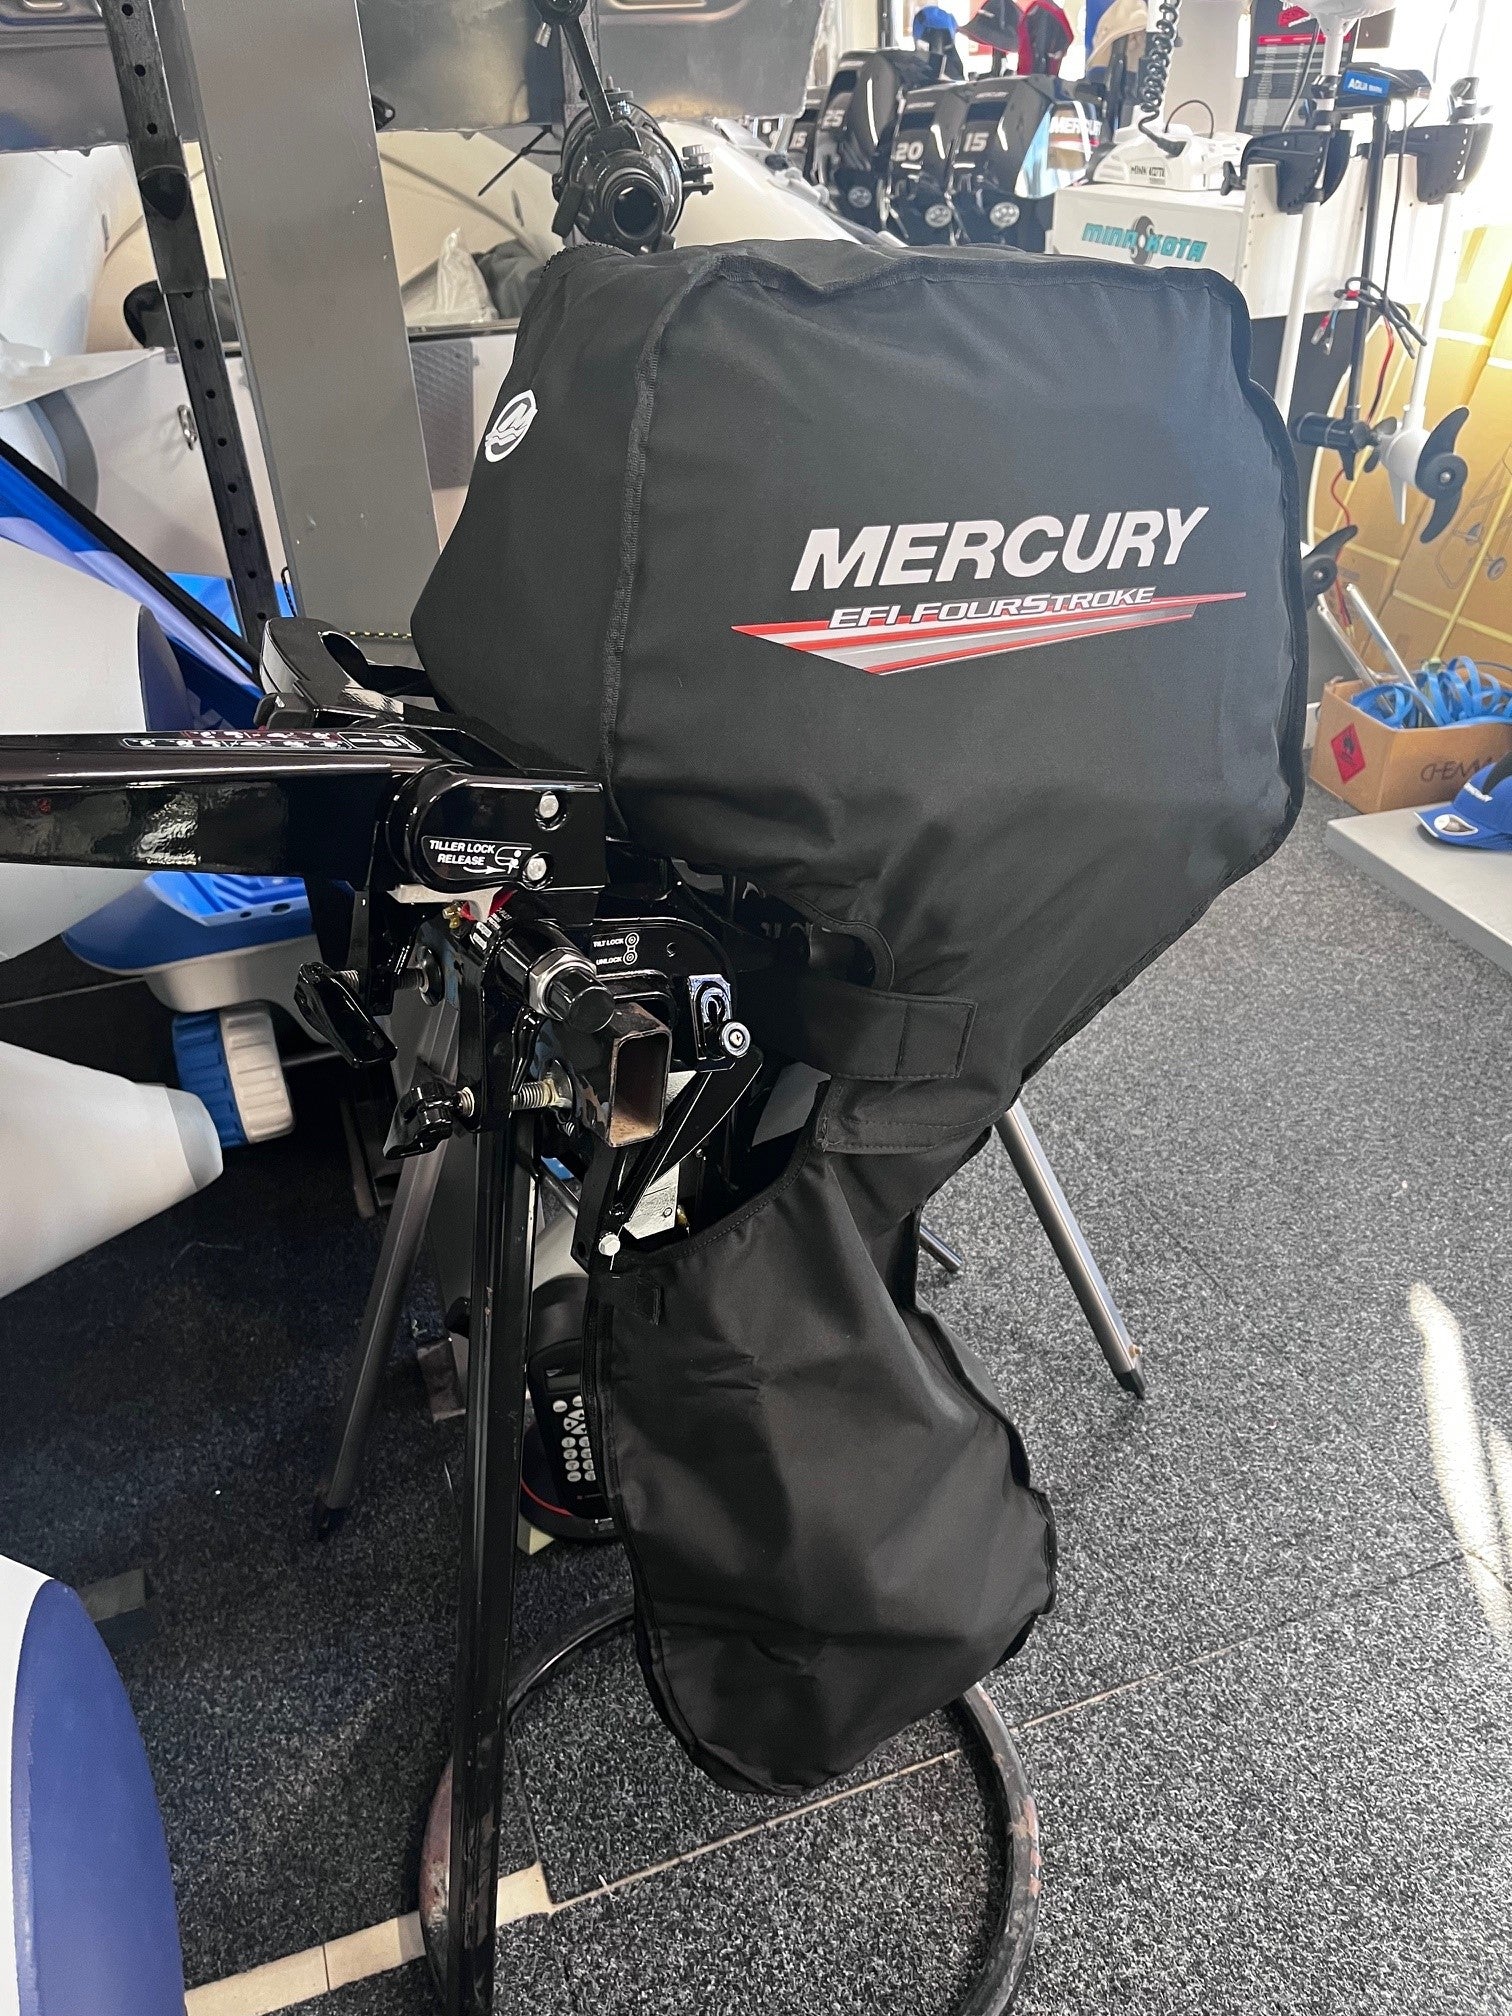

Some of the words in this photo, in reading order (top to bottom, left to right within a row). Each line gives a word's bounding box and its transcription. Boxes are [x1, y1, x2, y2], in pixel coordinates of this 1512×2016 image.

[821, 109, 846, 129] 25
[891, 141, 924, 162] 20
[963, 132, 989, 152] 15
[1146, 233, 1209, 263] KOTA
[790, 506, 1210, 592] MERCURY
[828, 604, 901, 630] EFI
[429, 840, 466, 852] TILLER
[467, 843, 496, 854] LOCK
[437, 854, 486, 866] RELEASE
[593, 940, 606, 948] TILT
[606, 938, 624, 946] LOCK
[595, 956, 622, 965] UNLOCK
